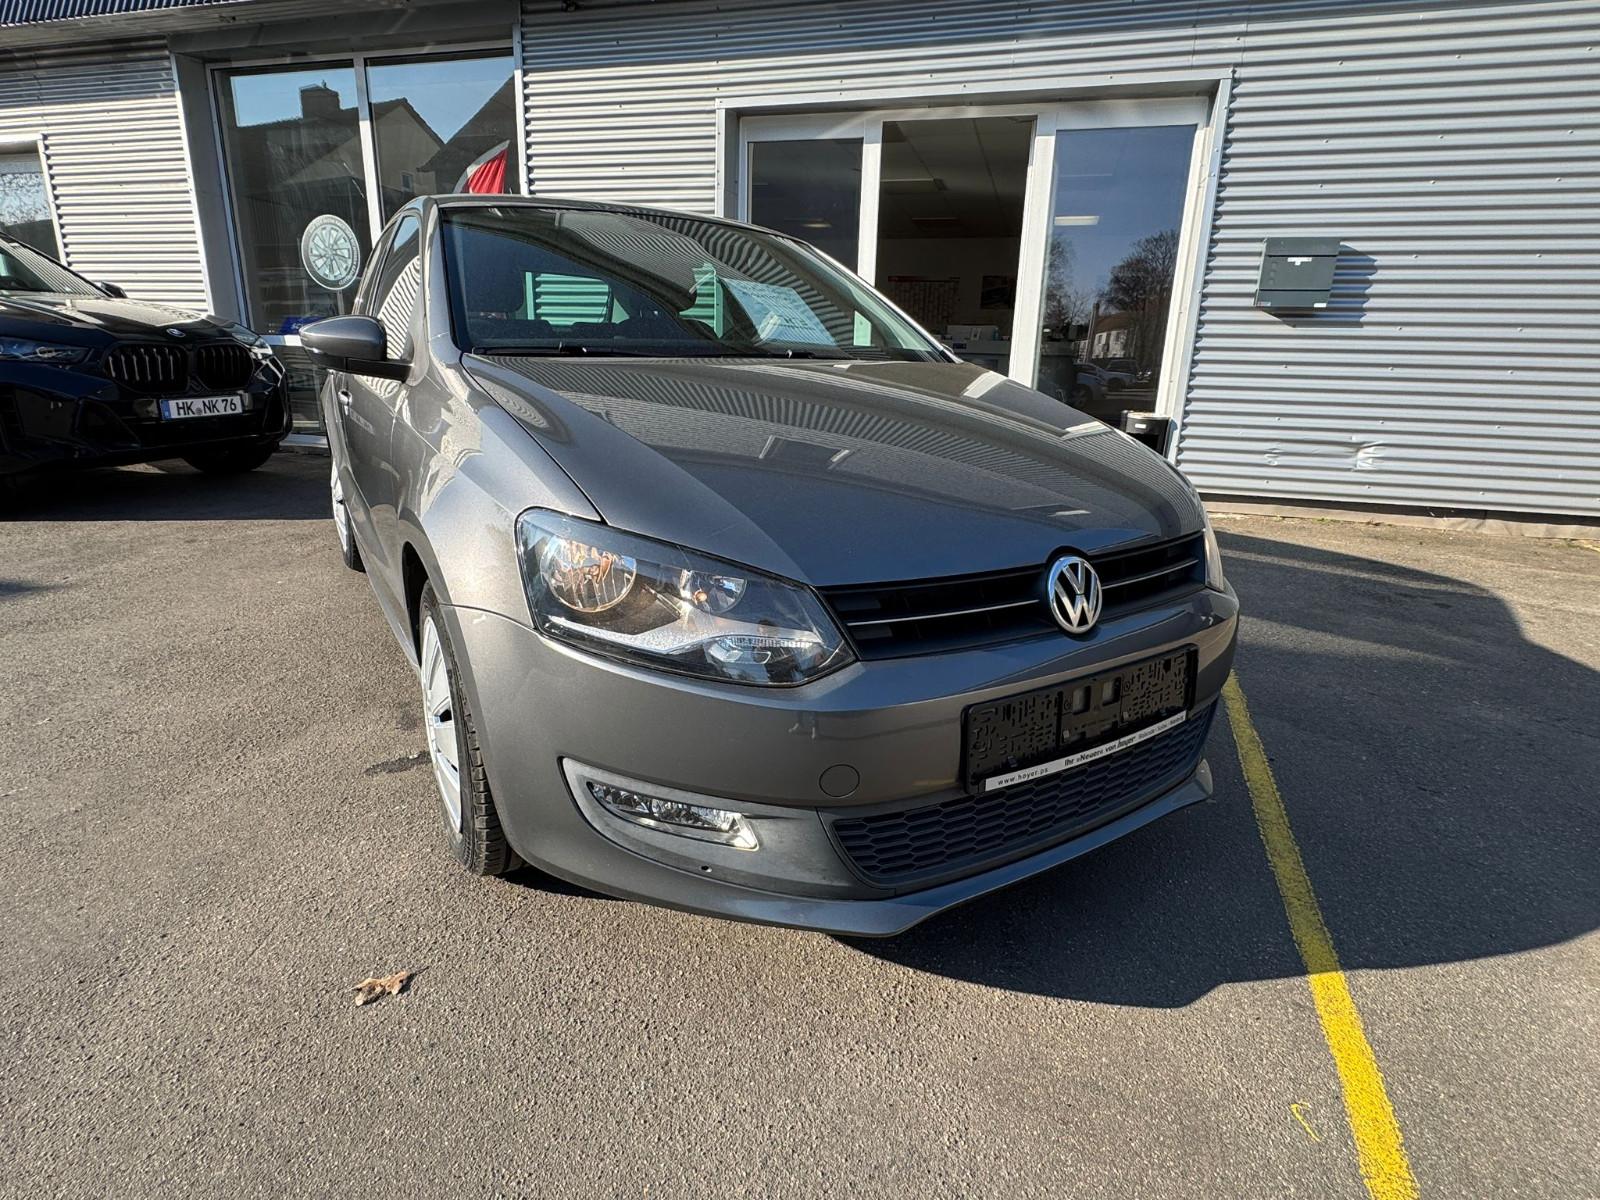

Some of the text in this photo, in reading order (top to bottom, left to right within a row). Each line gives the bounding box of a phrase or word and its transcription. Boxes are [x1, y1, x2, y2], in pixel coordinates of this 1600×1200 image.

[176, 399, 237, 416] HK NK 76
[1051, 559, 1100, 630] VW
